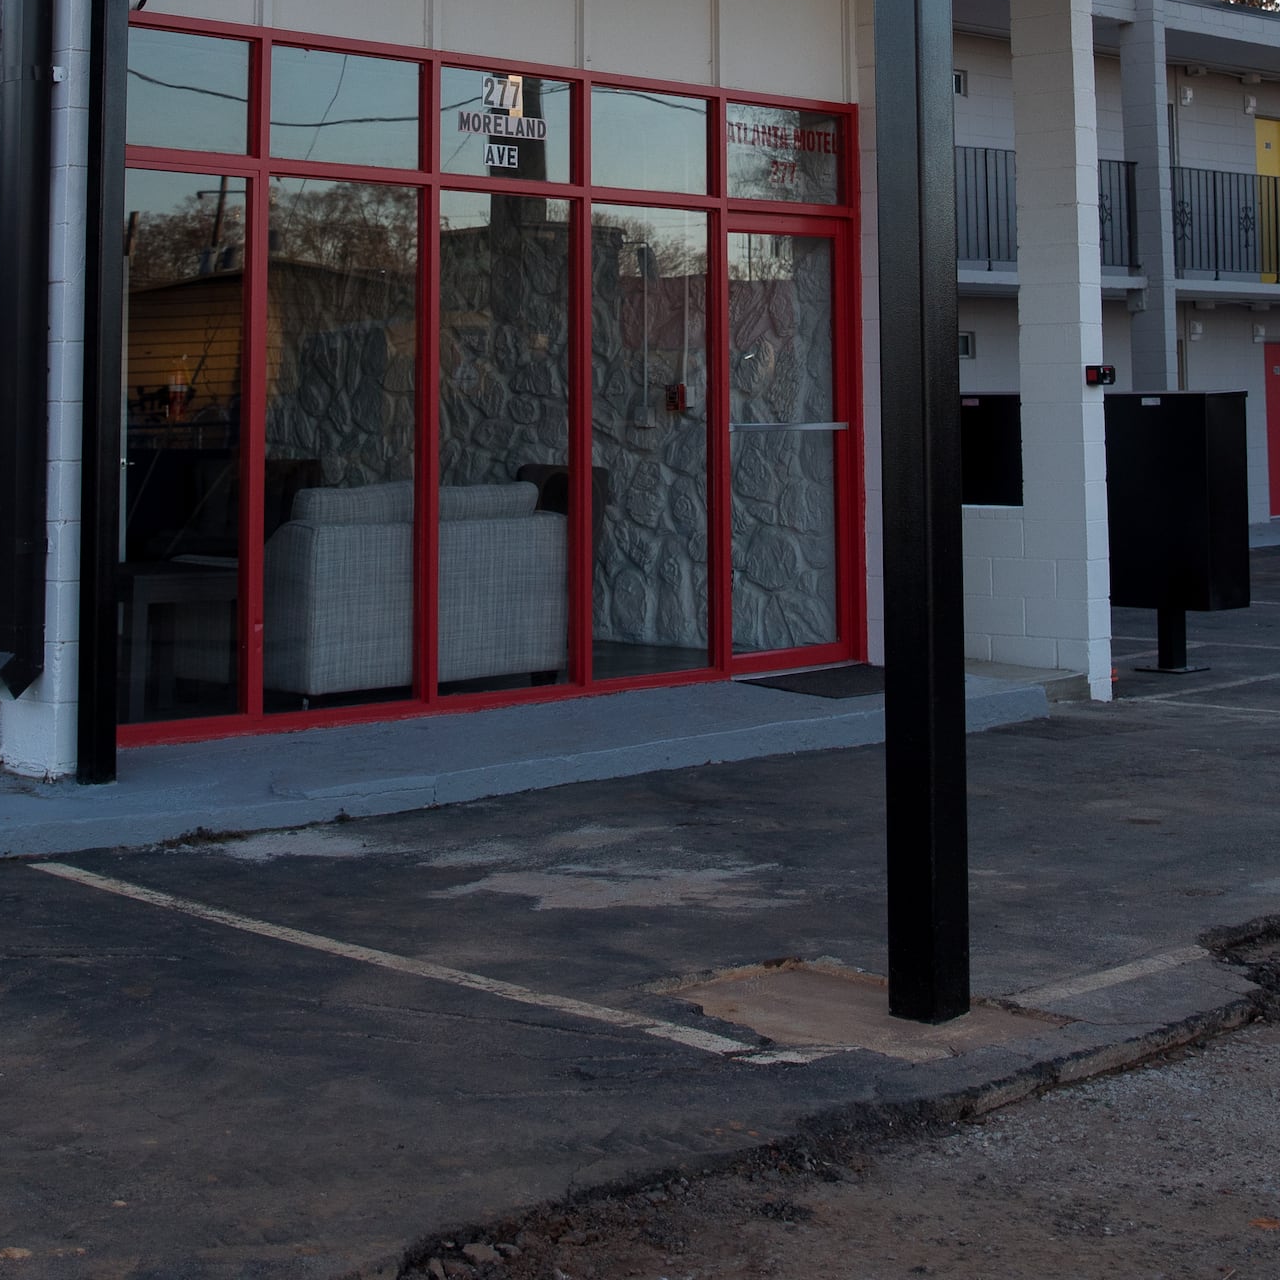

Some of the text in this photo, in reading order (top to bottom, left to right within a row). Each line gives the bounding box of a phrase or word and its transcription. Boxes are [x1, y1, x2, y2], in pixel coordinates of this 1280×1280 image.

[484, 76, 522, 110] 277
[458, 111, 547, 140] MORELAND
[726, 121, 839, 154] ATLANTA MOTEL
[485, 145, 518, 167] AVE
[770, 160, 797, 184] 277
